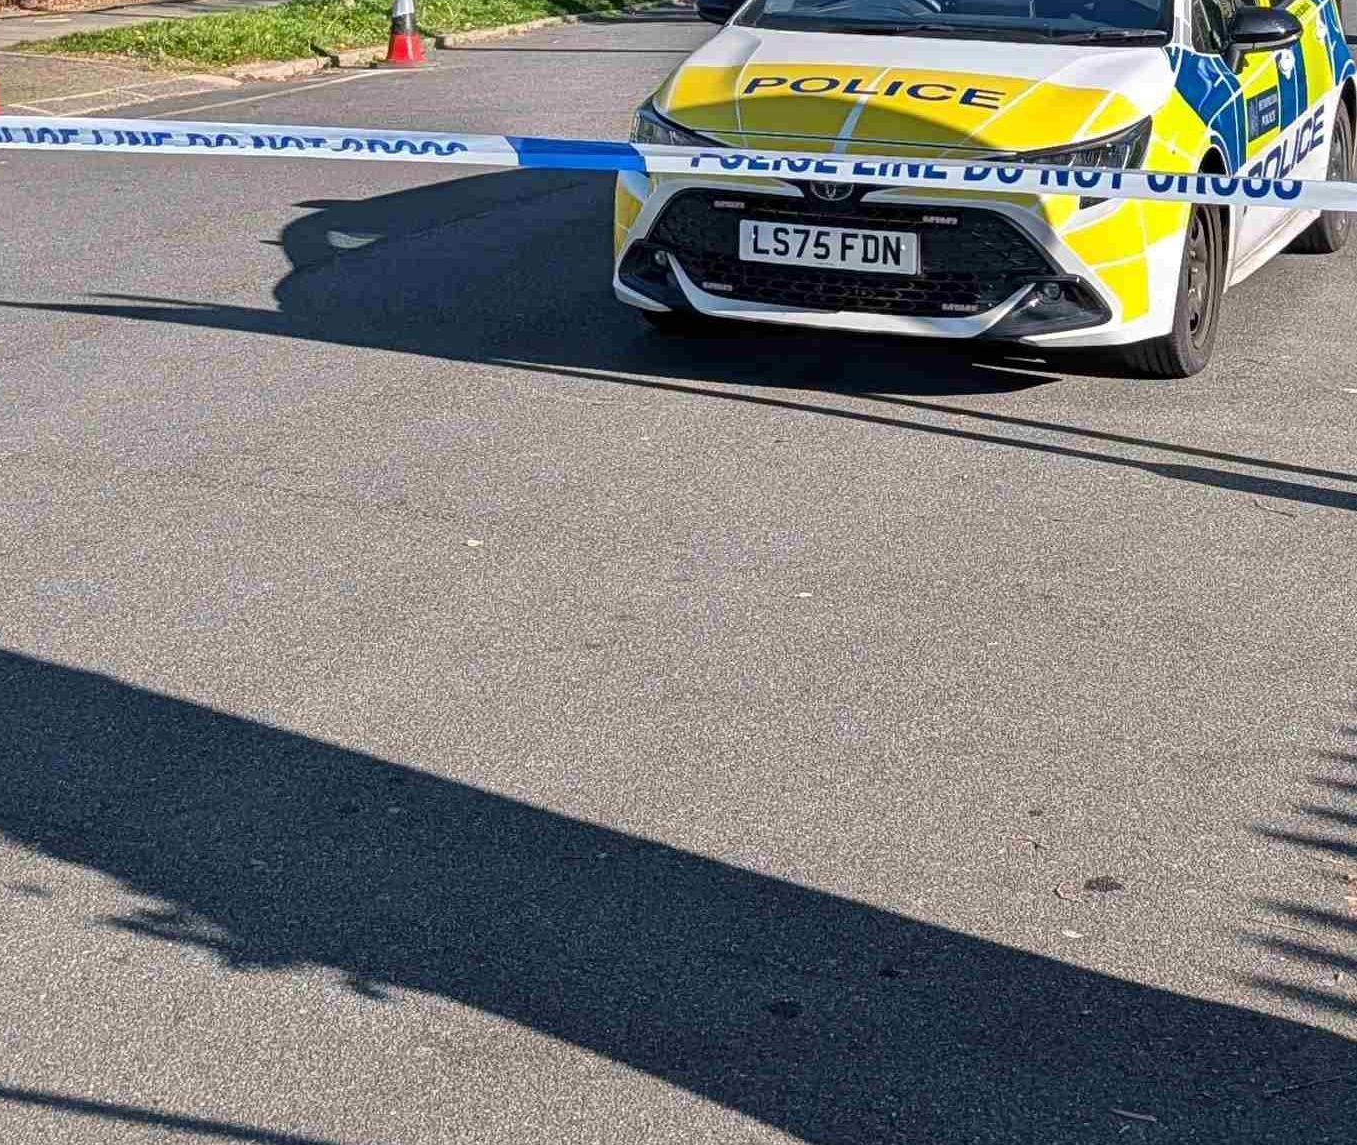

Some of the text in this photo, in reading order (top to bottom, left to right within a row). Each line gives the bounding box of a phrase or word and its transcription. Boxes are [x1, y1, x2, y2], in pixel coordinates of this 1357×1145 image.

[744, 77, 1008, 110] POLICE
[751, 224, 902, 266] LS75 FDN
